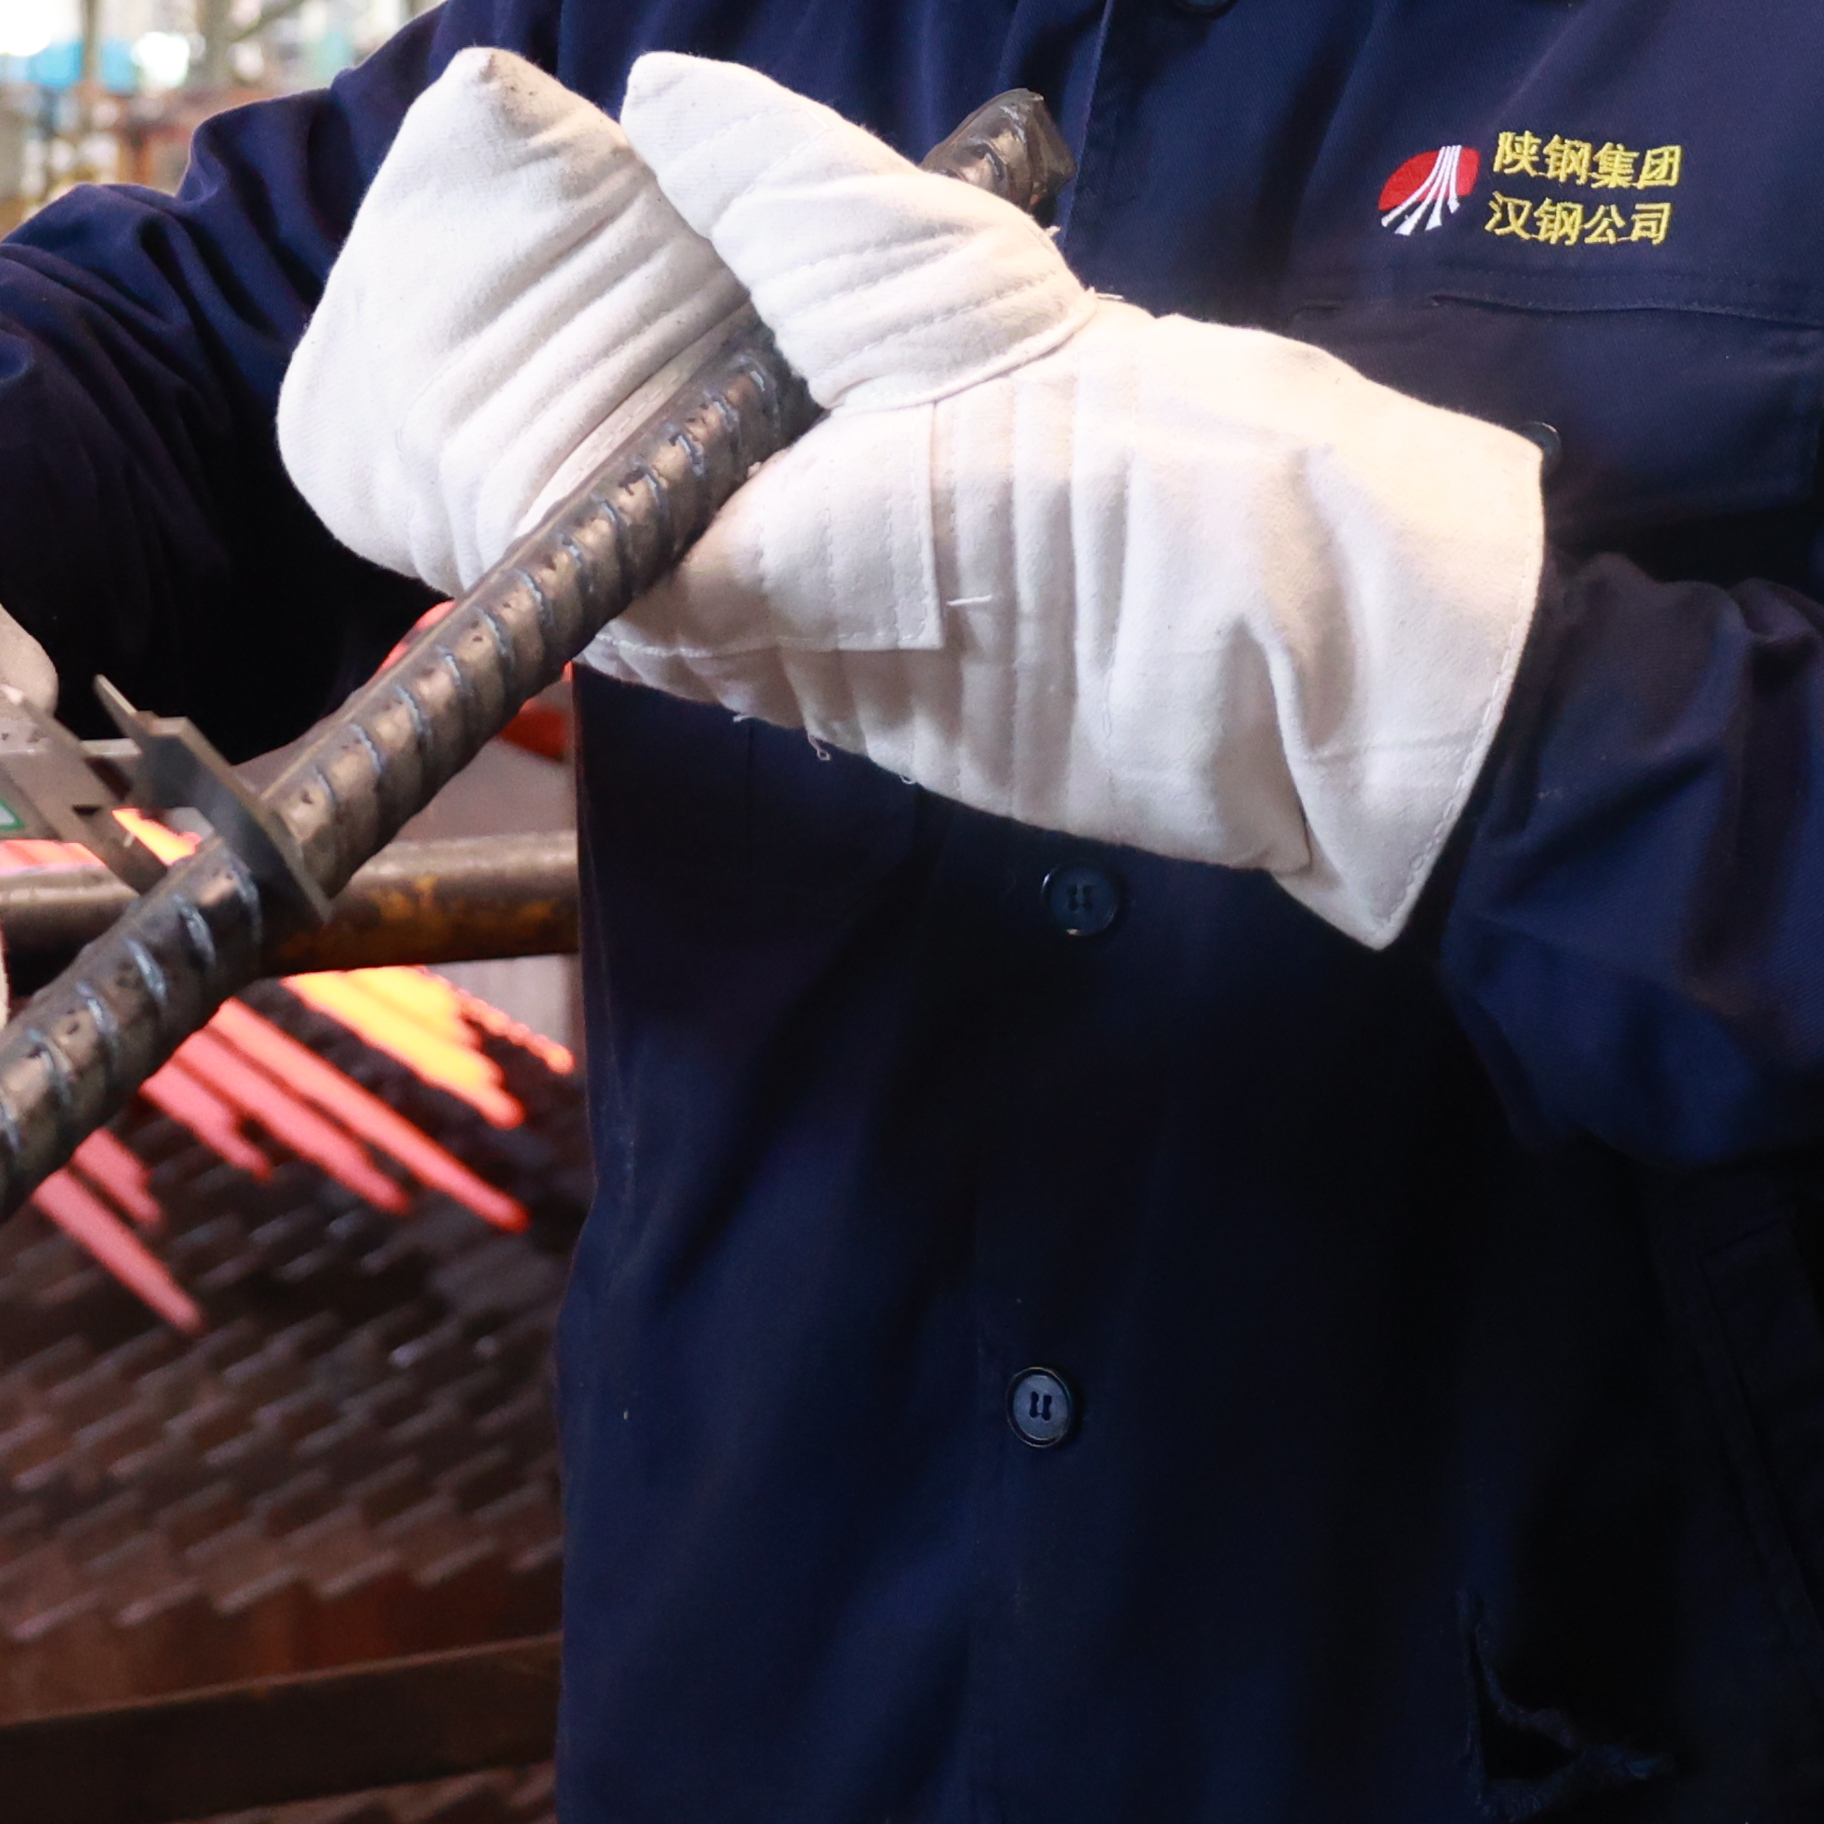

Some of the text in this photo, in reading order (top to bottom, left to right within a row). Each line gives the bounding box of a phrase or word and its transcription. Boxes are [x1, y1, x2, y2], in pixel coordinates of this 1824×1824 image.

[1493, 130, 1682, 189] 陕钢集团
[1484, 191, 1672, 245] 汉钢公司
